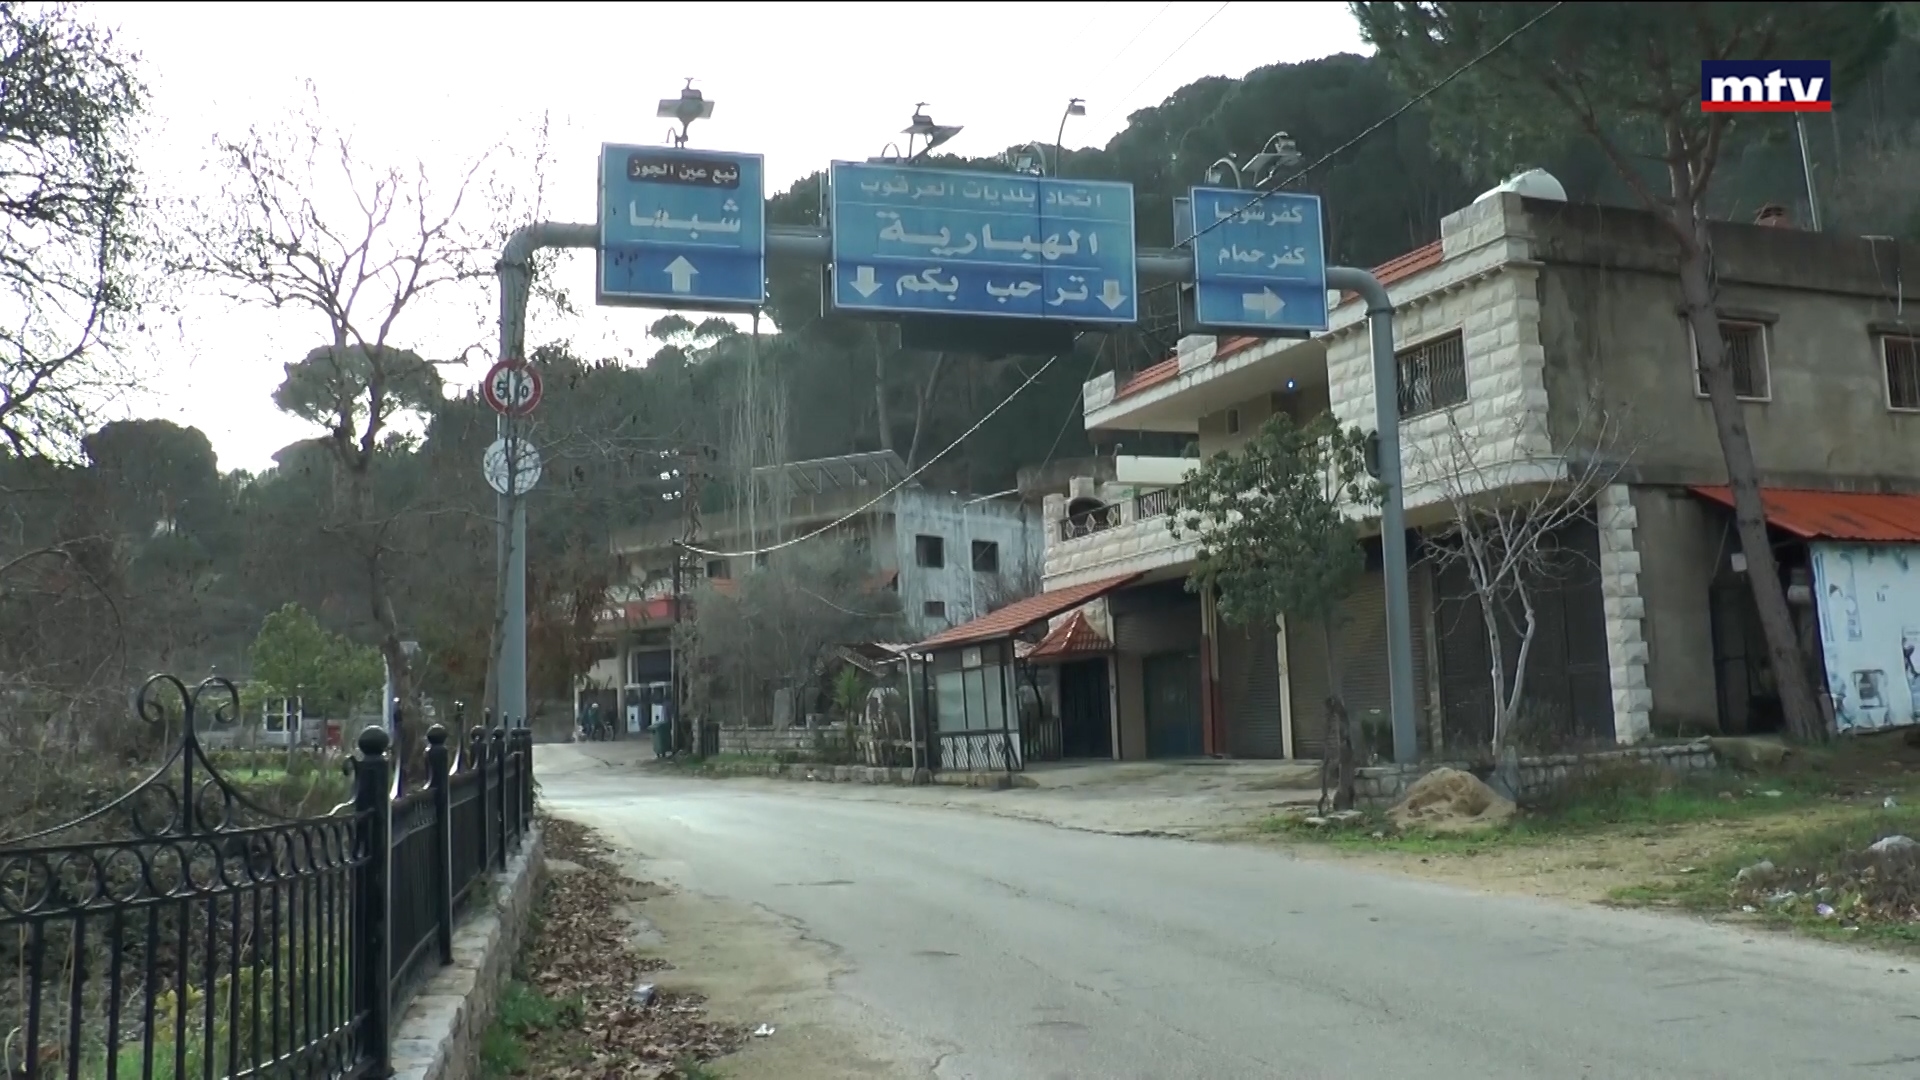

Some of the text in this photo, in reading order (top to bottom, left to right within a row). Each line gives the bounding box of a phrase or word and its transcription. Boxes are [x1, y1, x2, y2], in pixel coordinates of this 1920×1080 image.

[631, 159, 738, 184] نبع عين الجوز
[860, 175, 1101, 208] اتحاد بلديات العرقوب
[876, 210, 1098, 260] الهبارية
[895, 267, 959, 301] بكم
